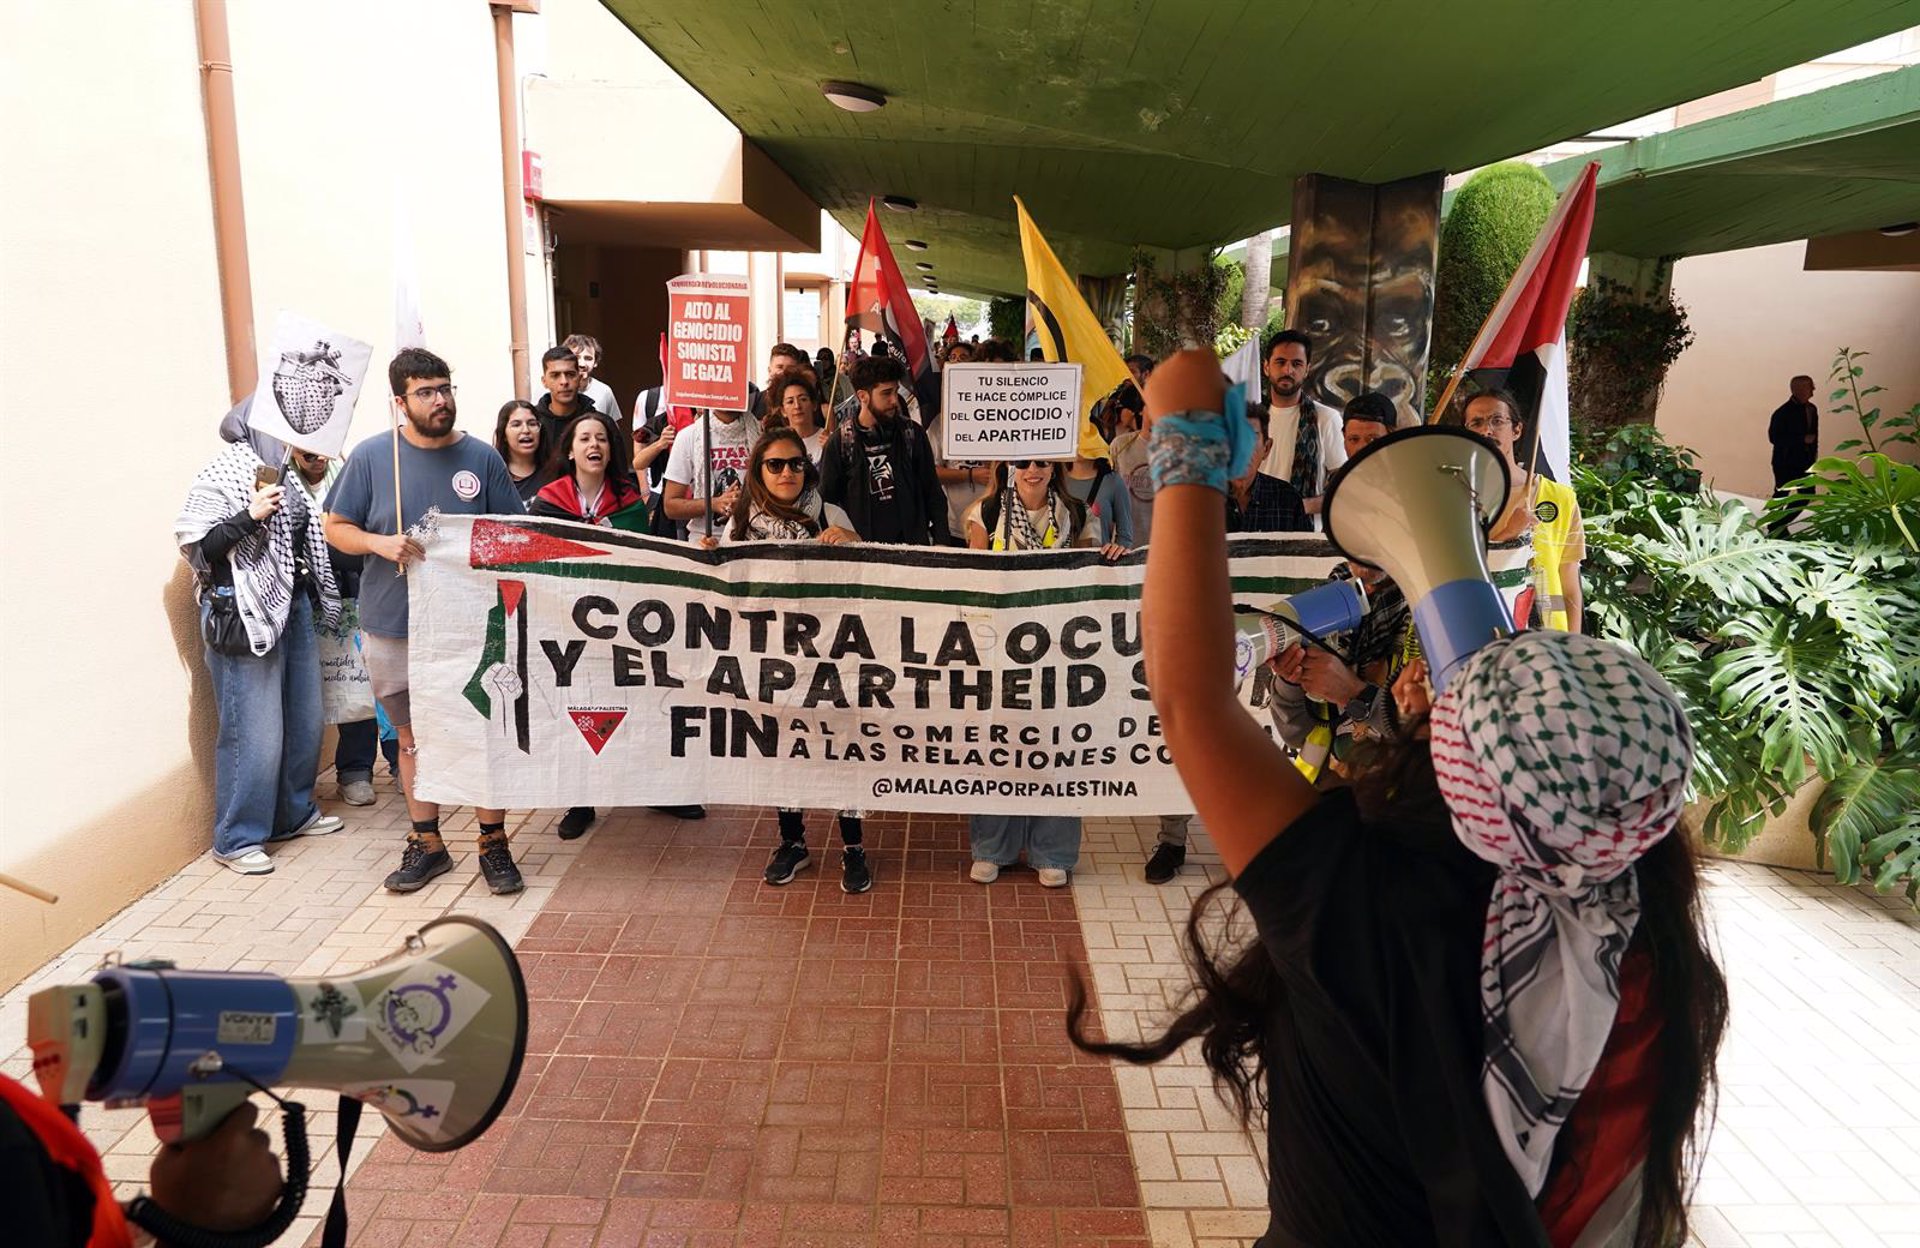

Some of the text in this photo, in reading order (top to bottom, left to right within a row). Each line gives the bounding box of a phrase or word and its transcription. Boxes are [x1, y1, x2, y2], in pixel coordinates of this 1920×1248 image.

[683, 301, 731, 321] ALTO AL
[673, 321, 743, 343] GENOCIDIO
[677, 342, 737, 363] SIONISTA
[682, 362, 733, 384] DE GAZA
[978, 376, 1049, 386] TU SILENCIO
[957, 390, 1067, 402] TE HACE CÓMPLICE
[950, 406, 1073, 421] DEL GENOCIDIO Y
[954, 427, 1067, 442] DEL APARTHEID
[571, 594, 876, 660] CONTRA
[900, 616, 981, 670] LA
[539, 640, 588, 688] Y
[611, 644, 685, 689] EL
[705, 655, 1107, 711] APARTHEID
[670, 705, 780, 758] FIN
[789, 718, 835, 736] AL
[860, 723, 1093, 746] COMERCIO
[789, 737, 811, 760] A
[824, 738, 887, 762] LAS
[901, 741, 1117, 770] RELACIONES
[872, 778, 1138, 798] @MALAGAPORPALESTINA
